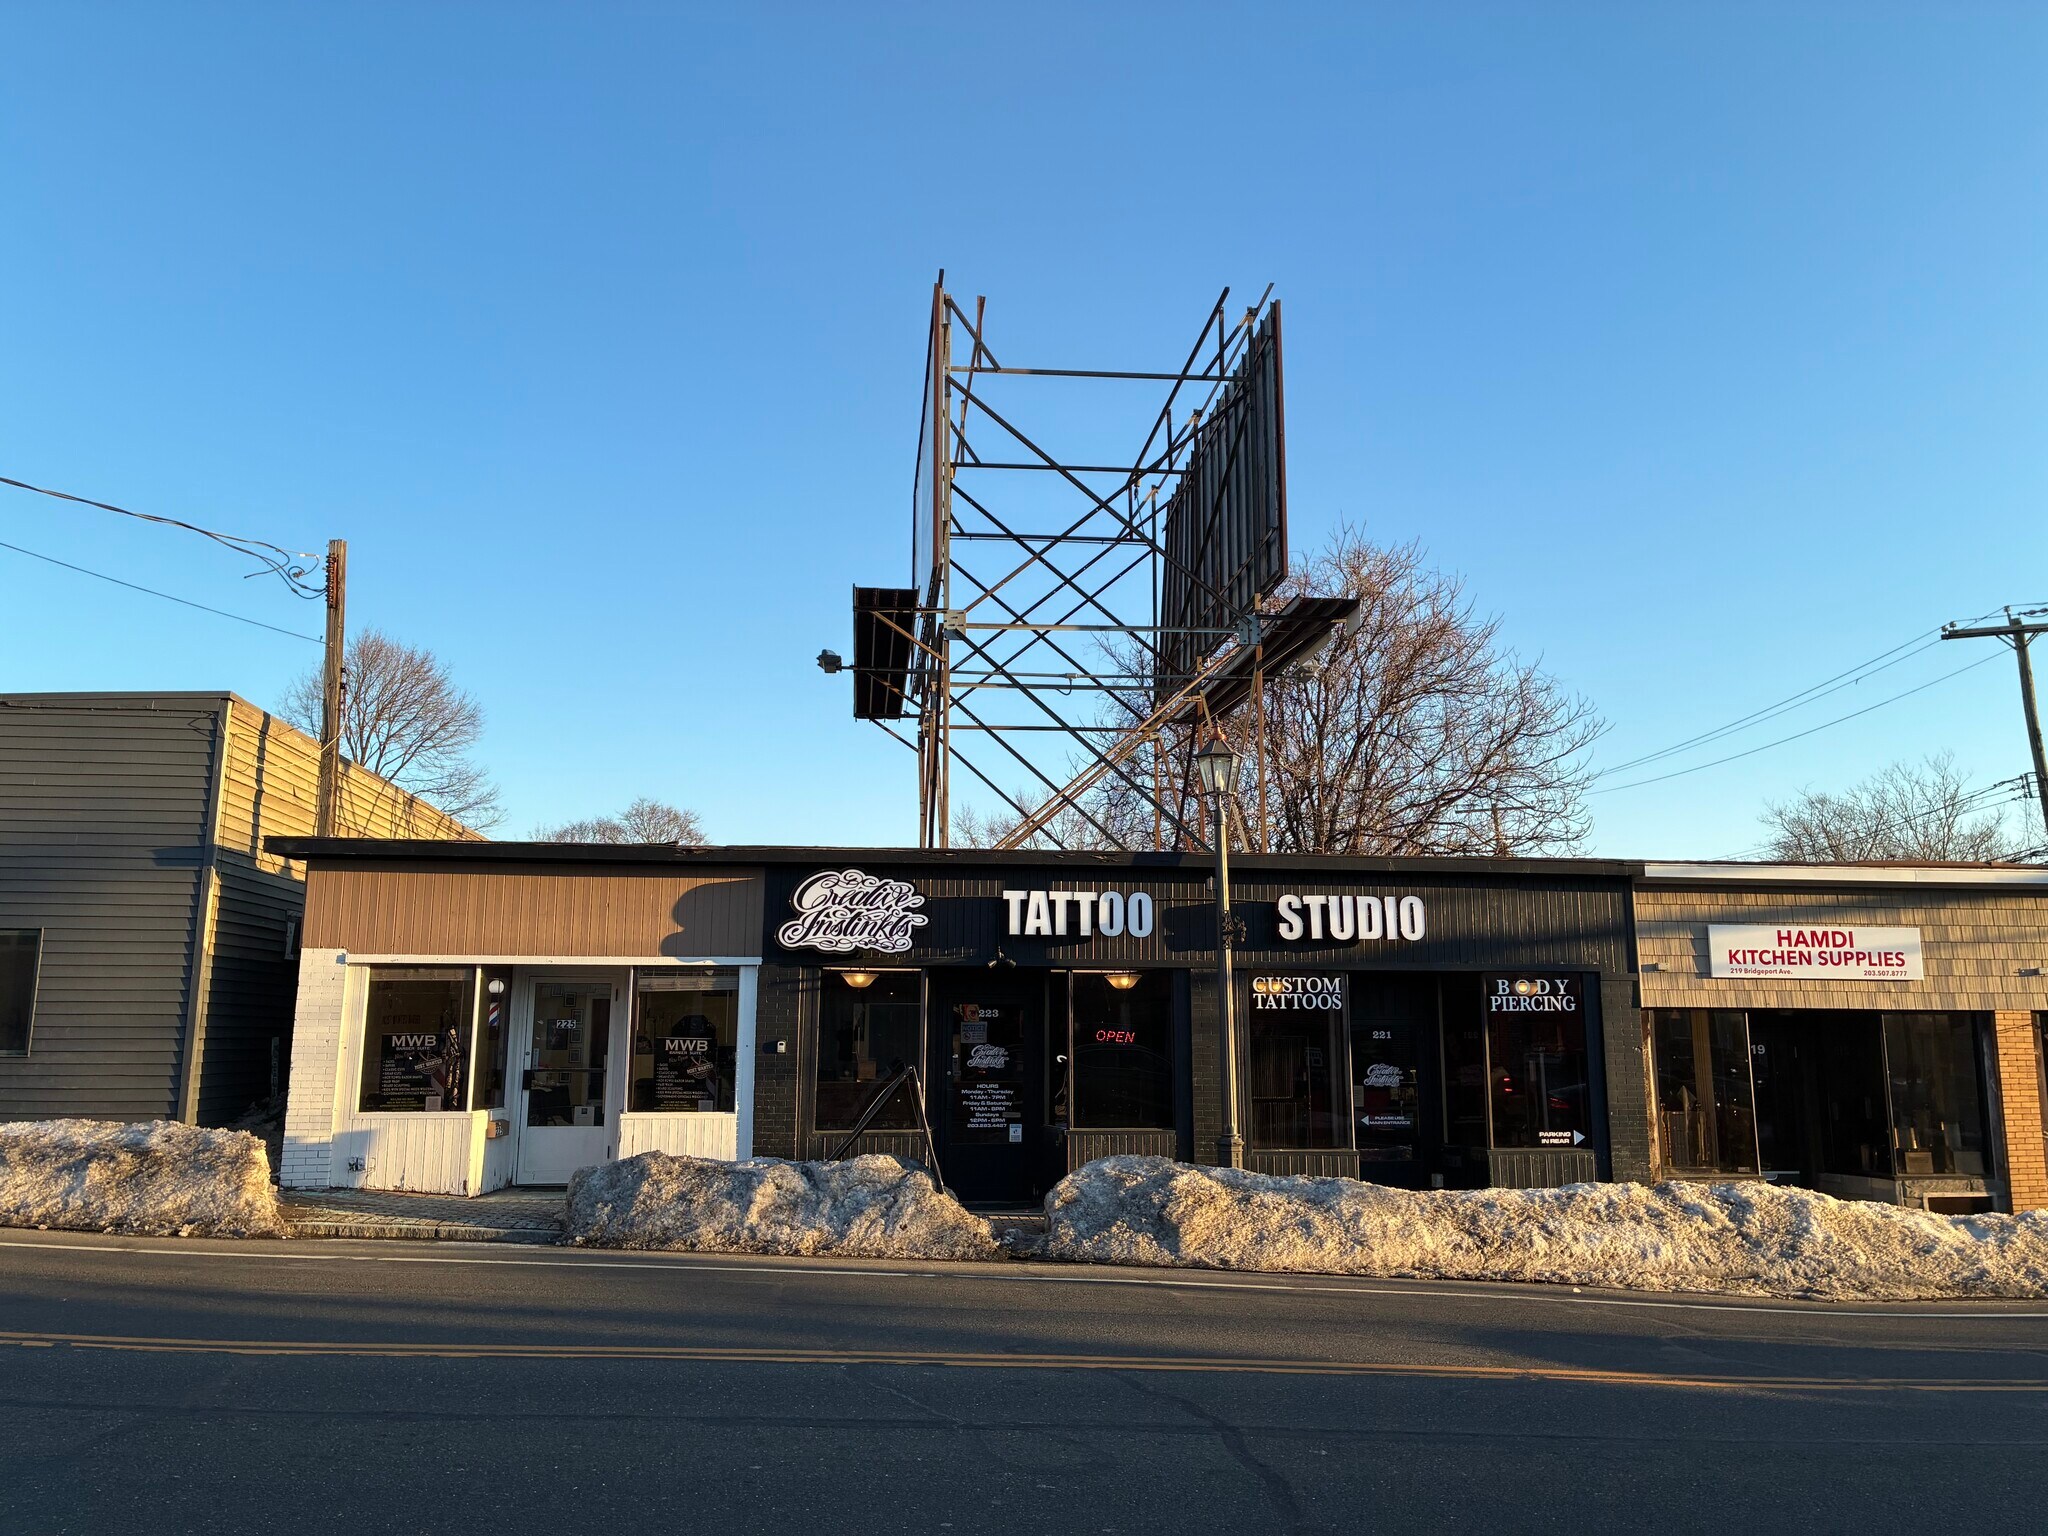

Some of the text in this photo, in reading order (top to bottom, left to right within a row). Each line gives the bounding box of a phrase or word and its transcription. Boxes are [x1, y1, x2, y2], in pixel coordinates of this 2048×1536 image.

[792, 870, 928, 912] Creative
[1003, 890, 1154, 939] TATTOO
[1277, 894, 1426, 942] STUDIO
[1776, 929, 1854, 949] HAMDI
[1728, 949, 1906, 968] KITCHEN SUPPLIES
[1744, 967, 1777, 976] Bridgeport
[1252, 976, 1341, 994] CUSTOM
[1496, 978, 1571, 995] BODY
[1252, 993, 1343, 1011] TATTOOS
[1490, 995, 1576, 1012] PIERCING
[978, 1009, 999, 1018] 223
[556, 1019, 577, 1029] 225
[392, 1035, 437, 1047] MWB
[1095, 1029, 1136, 1044] OPEN
[1372, 1030, 1392, 1040] 221
[664, 1039, 709, 1052] MWB
[1751, 1044, 1766, 1055] 19
